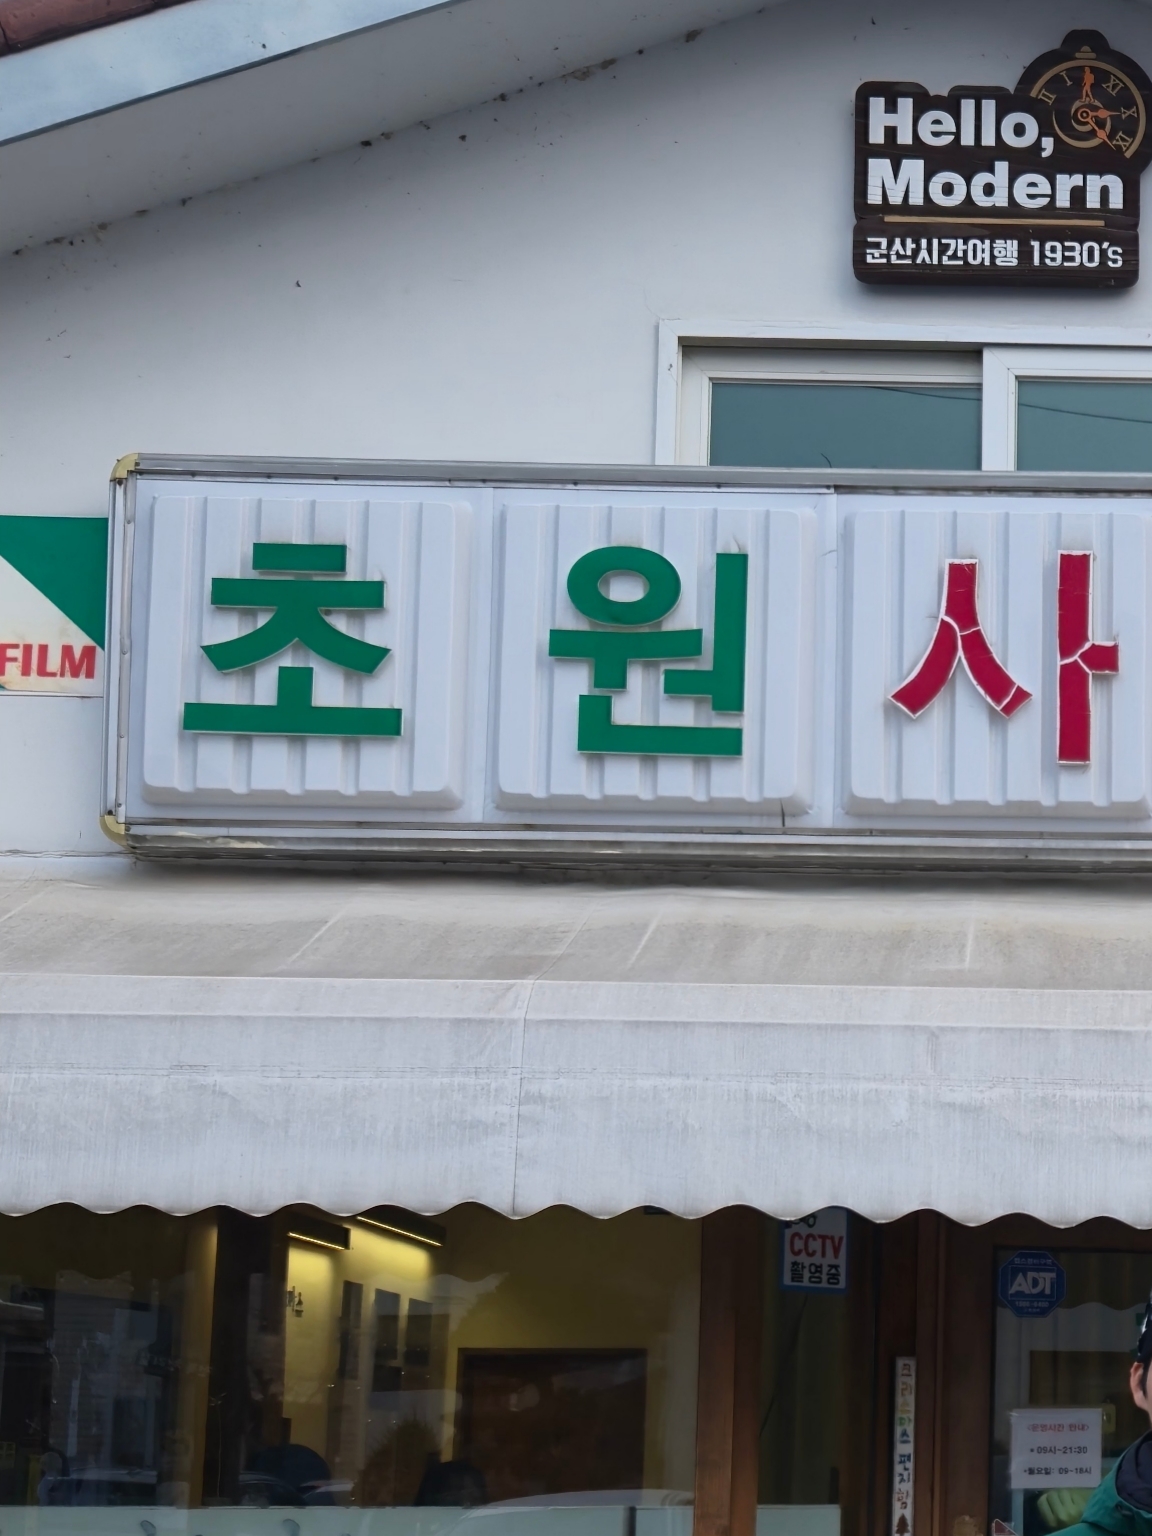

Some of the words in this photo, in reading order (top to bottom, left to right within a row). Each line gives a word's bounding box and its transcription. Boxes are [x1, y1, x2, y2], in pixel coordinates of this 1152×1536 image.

[868, 97, 1054, 157] Hello,
[867, 158, 1124, 209] Modern
[866, 237, 1019, 267] 군산시간여행
[1030, 241, 1123, 268] 1930's
[0, 643, 96, 679] FILM
[790, 1232, 843, 1260] CCTV
[790, 1260, 841, 1286] 촬영중
[1009, 1271, 1056, 1295] ADT
